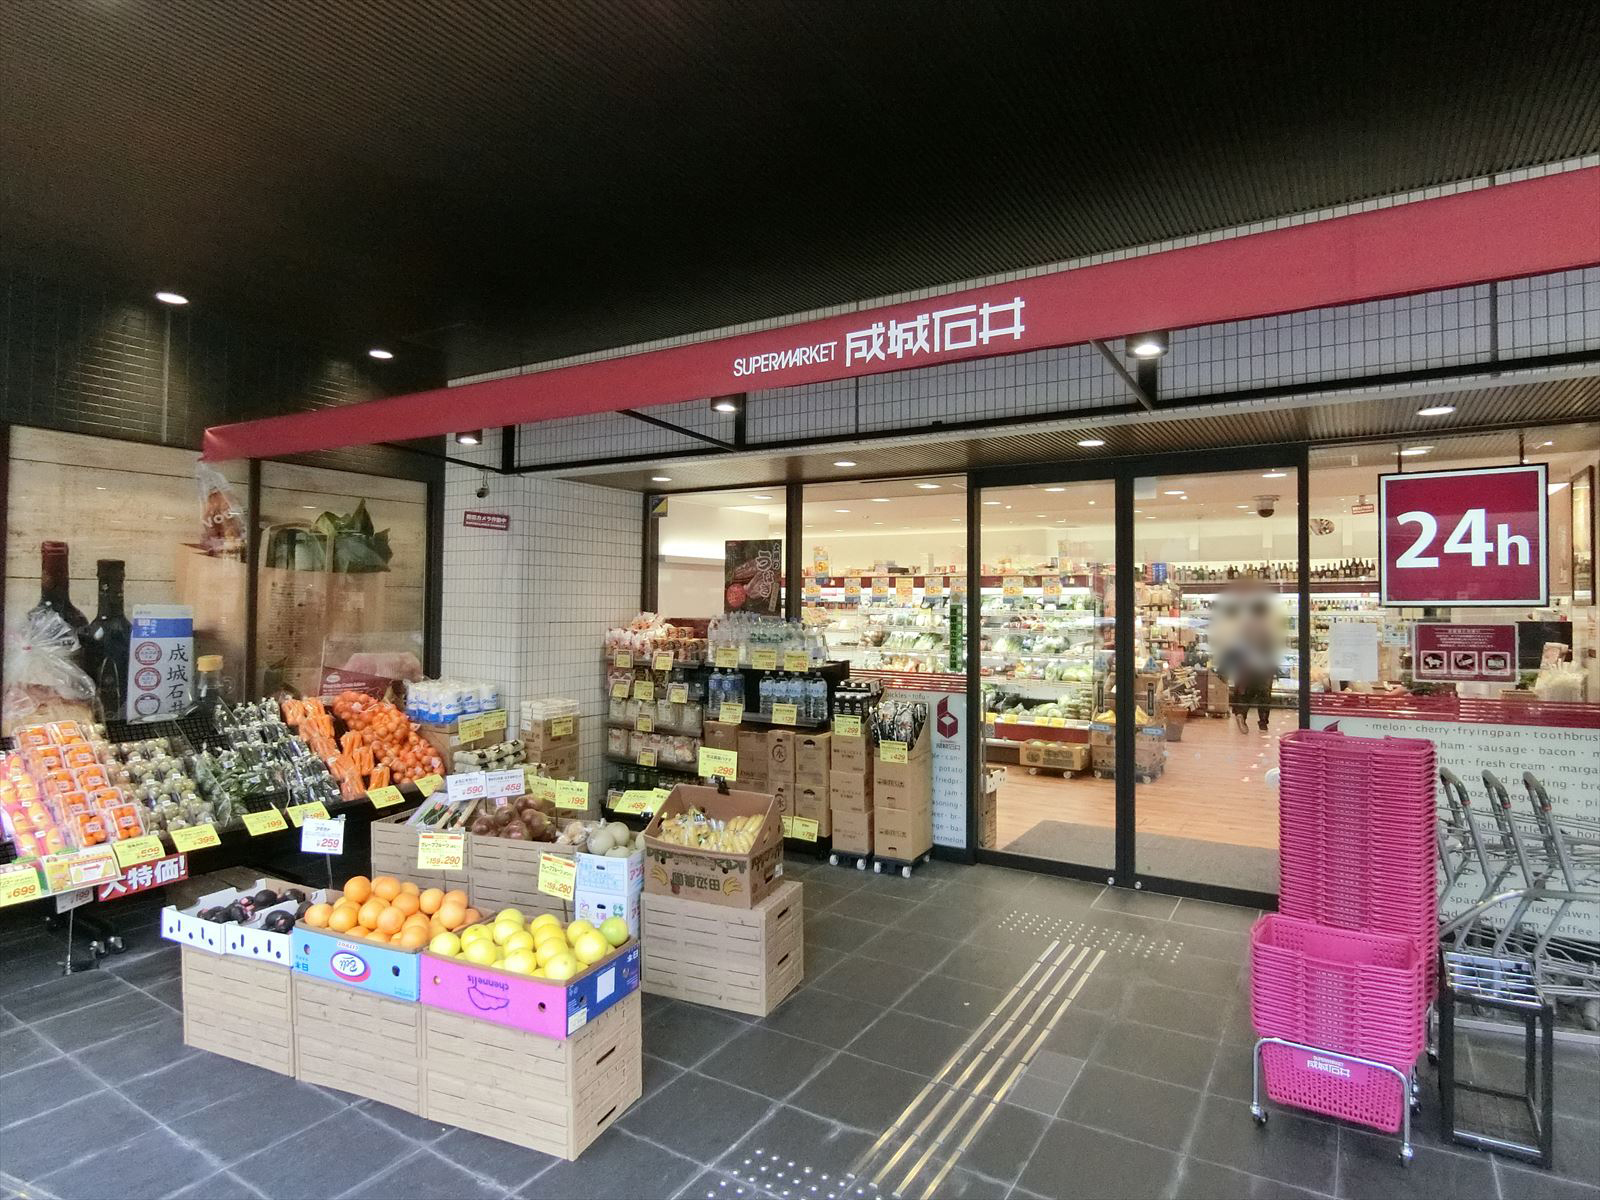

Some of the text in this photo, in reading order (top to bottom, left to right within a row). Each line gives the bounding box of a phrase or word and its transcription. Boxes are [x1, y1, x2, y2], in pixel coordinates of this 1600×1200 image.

[733, 297, 1025, 377] SUPERMARKET 成城石井
[1395, 508, 1530, 569] 24h
[1372, 722, 1406, 732] melon
[1415, 725, 1449, 735] cherry
[1457, 725, 1520, 739] fryingpan
[1440, 741, 1576, 757] ham sausage bacon
[1476, 758, 1507, 768] fresh
[1510, 761, 1545, 772] cream
[467, 974, 510, 991] chennells
